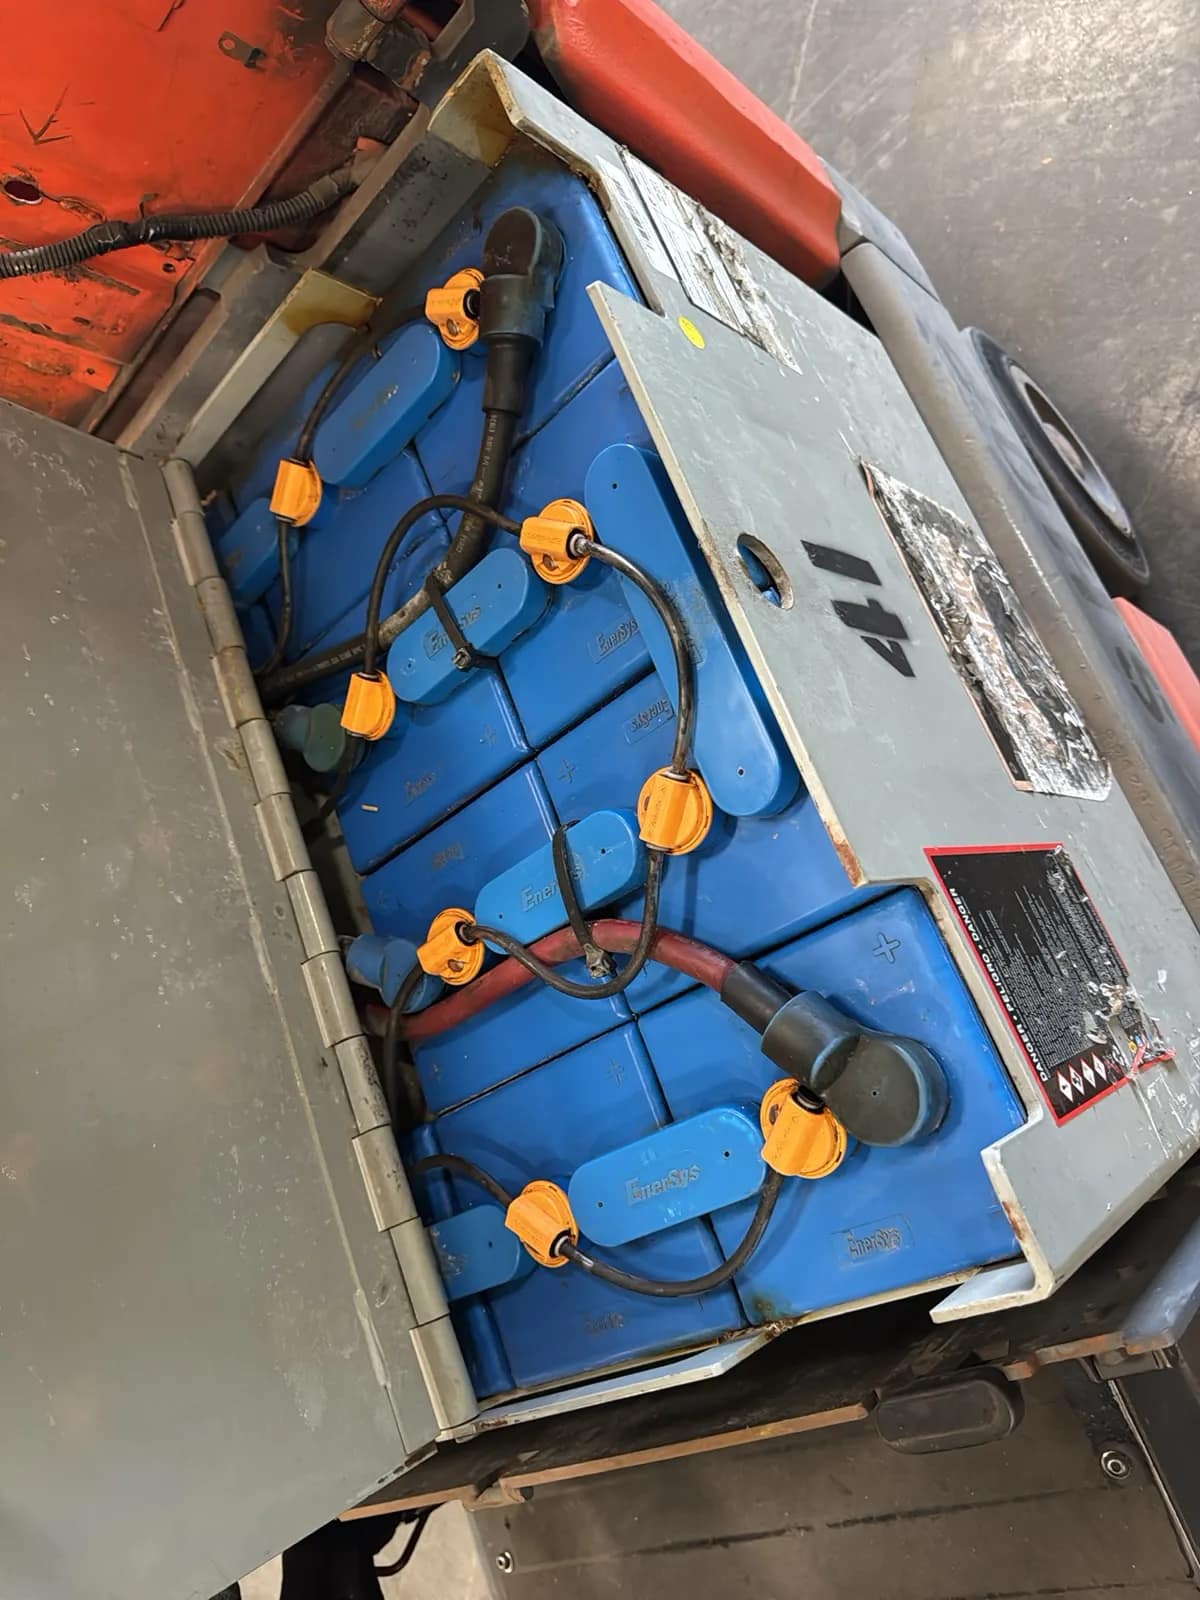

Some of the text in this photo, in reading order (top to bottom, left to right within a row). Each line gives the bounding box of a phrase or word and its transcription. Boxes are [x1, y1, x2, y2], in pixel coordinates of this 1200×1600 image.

[596, 619, 639, 654] EnerSys
[949, 888, 1048, 1082] DANGER PELIGRO DANGER
[625, 1163, 702, 1206] EnerSys
